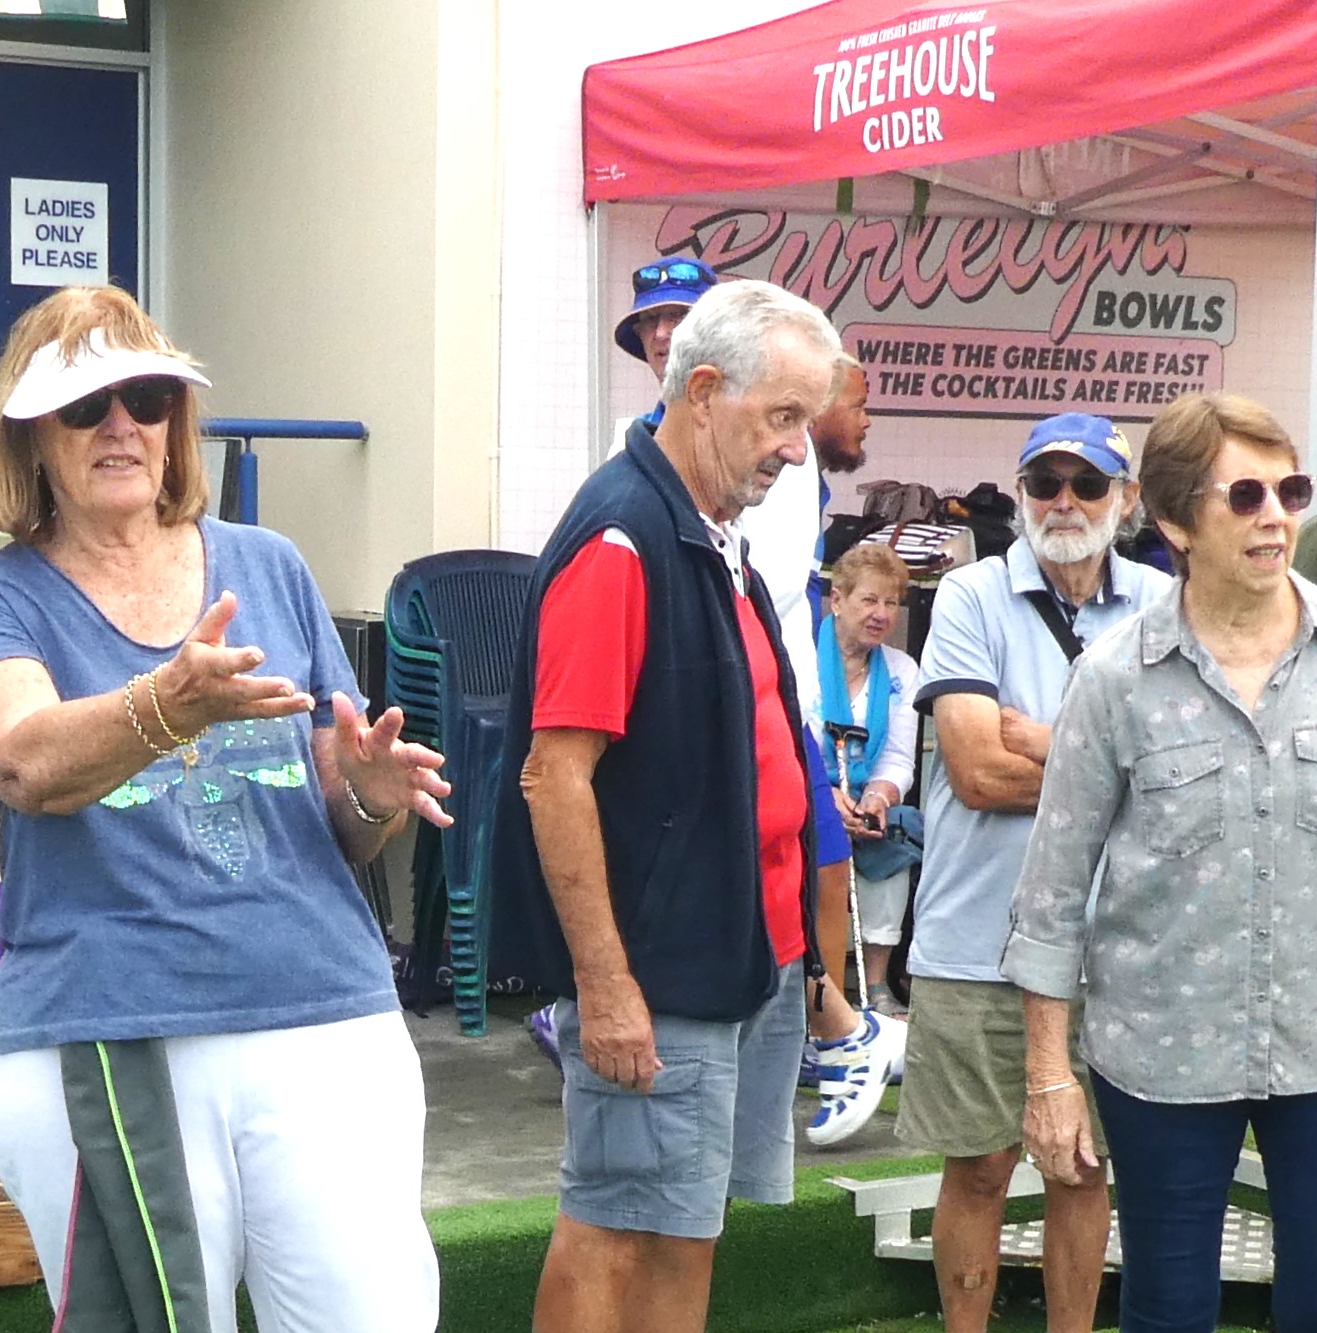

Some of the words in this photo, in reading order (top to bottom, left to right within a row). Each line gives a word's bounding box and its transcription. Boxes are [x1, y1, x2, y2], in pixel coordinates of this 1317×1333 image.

[813, 26, 997, 133] TREEHOUSE
[863, 106, 944, 153] CIDER
[24, 197, 96, 219] LADIES
[35, 223, 85, 243] ONLY
[21, 248, 99, 270] PLEASE
[1093, 290, 1226, 332] BOWLS
[857, 340, 945, 366] WHERE
[952, 343, 997, 369] THE
[1003, 345, 1096, 373] GREENS
[1101, 350, 1149, 374] ARE
[1152, 352, 1209, 376] FAST
[879, 371, 924, 396] THE
[930, 374, 1065, 401] COCKTAILS
[1070, 379, 1120, 403] ARE
